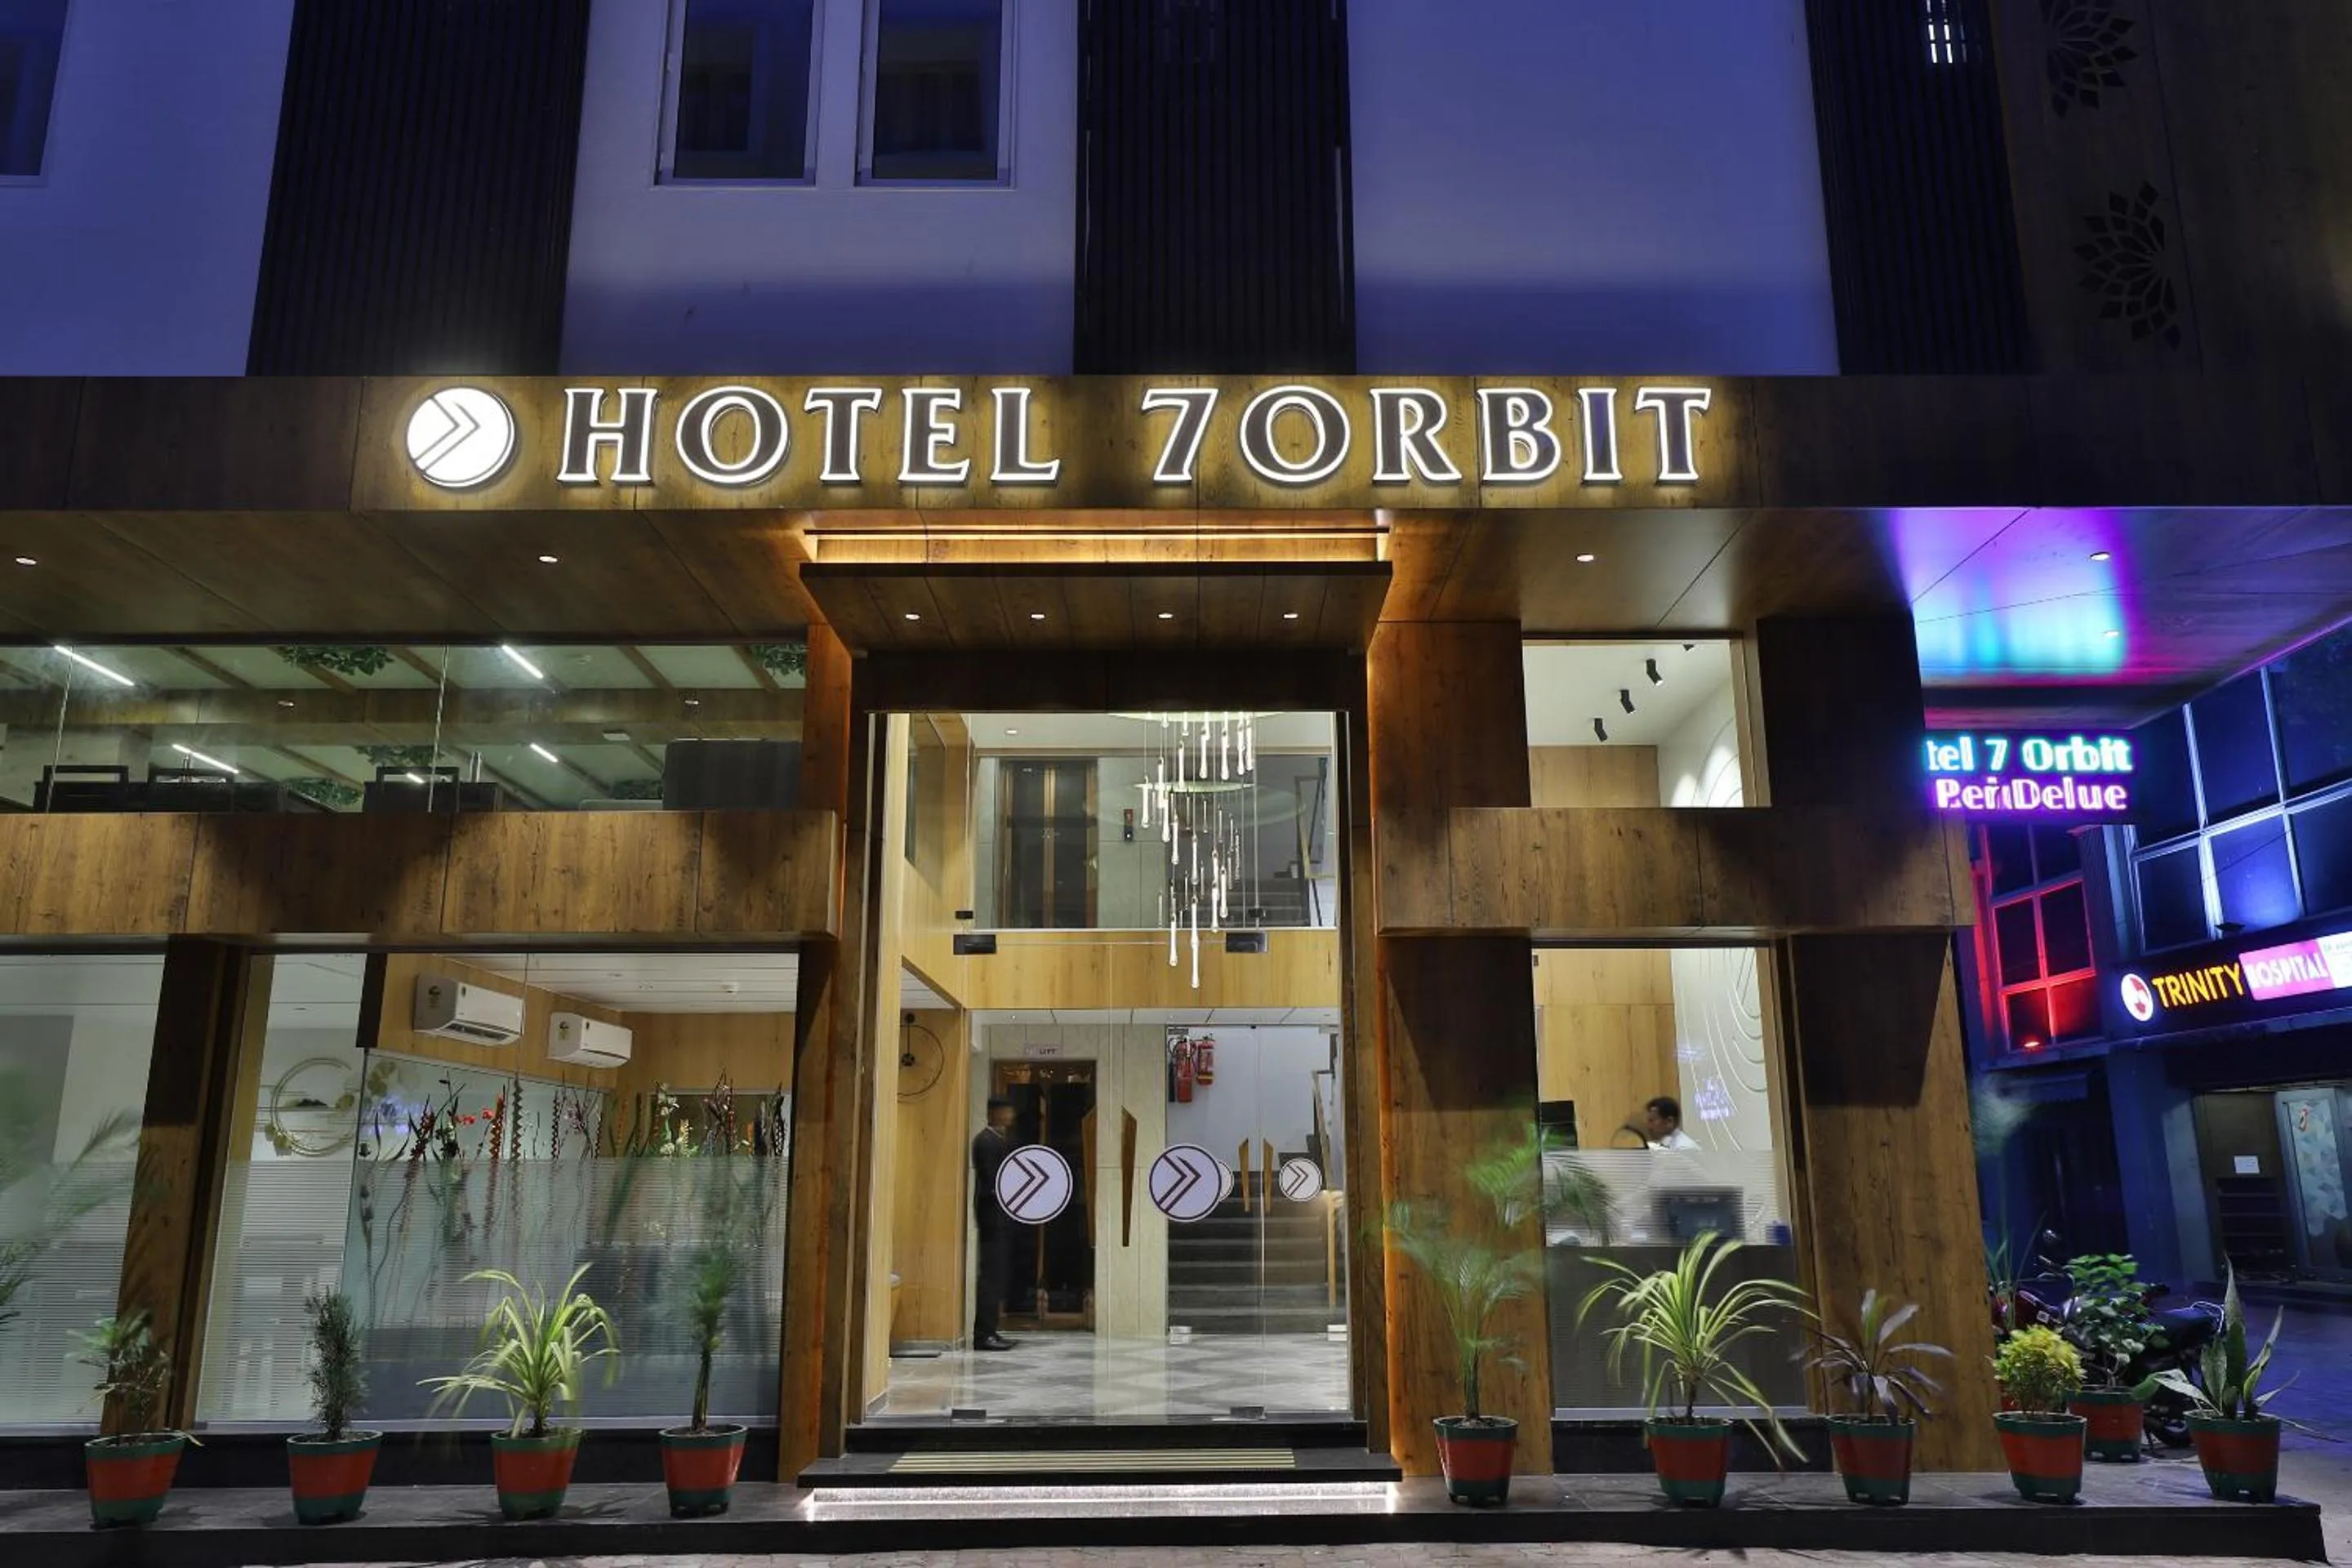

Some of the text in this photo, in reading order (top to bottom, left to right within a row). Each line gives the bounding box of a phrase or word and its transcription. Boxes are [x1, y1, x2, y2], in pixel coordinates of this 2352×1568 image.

[557, 385, 1061, 484] HOTEL
[1984, 738, 2007, 771] 7
[2021, 736, 2133, 771] Orbit
[2151, 962, 2245, 1008] TRINITY
